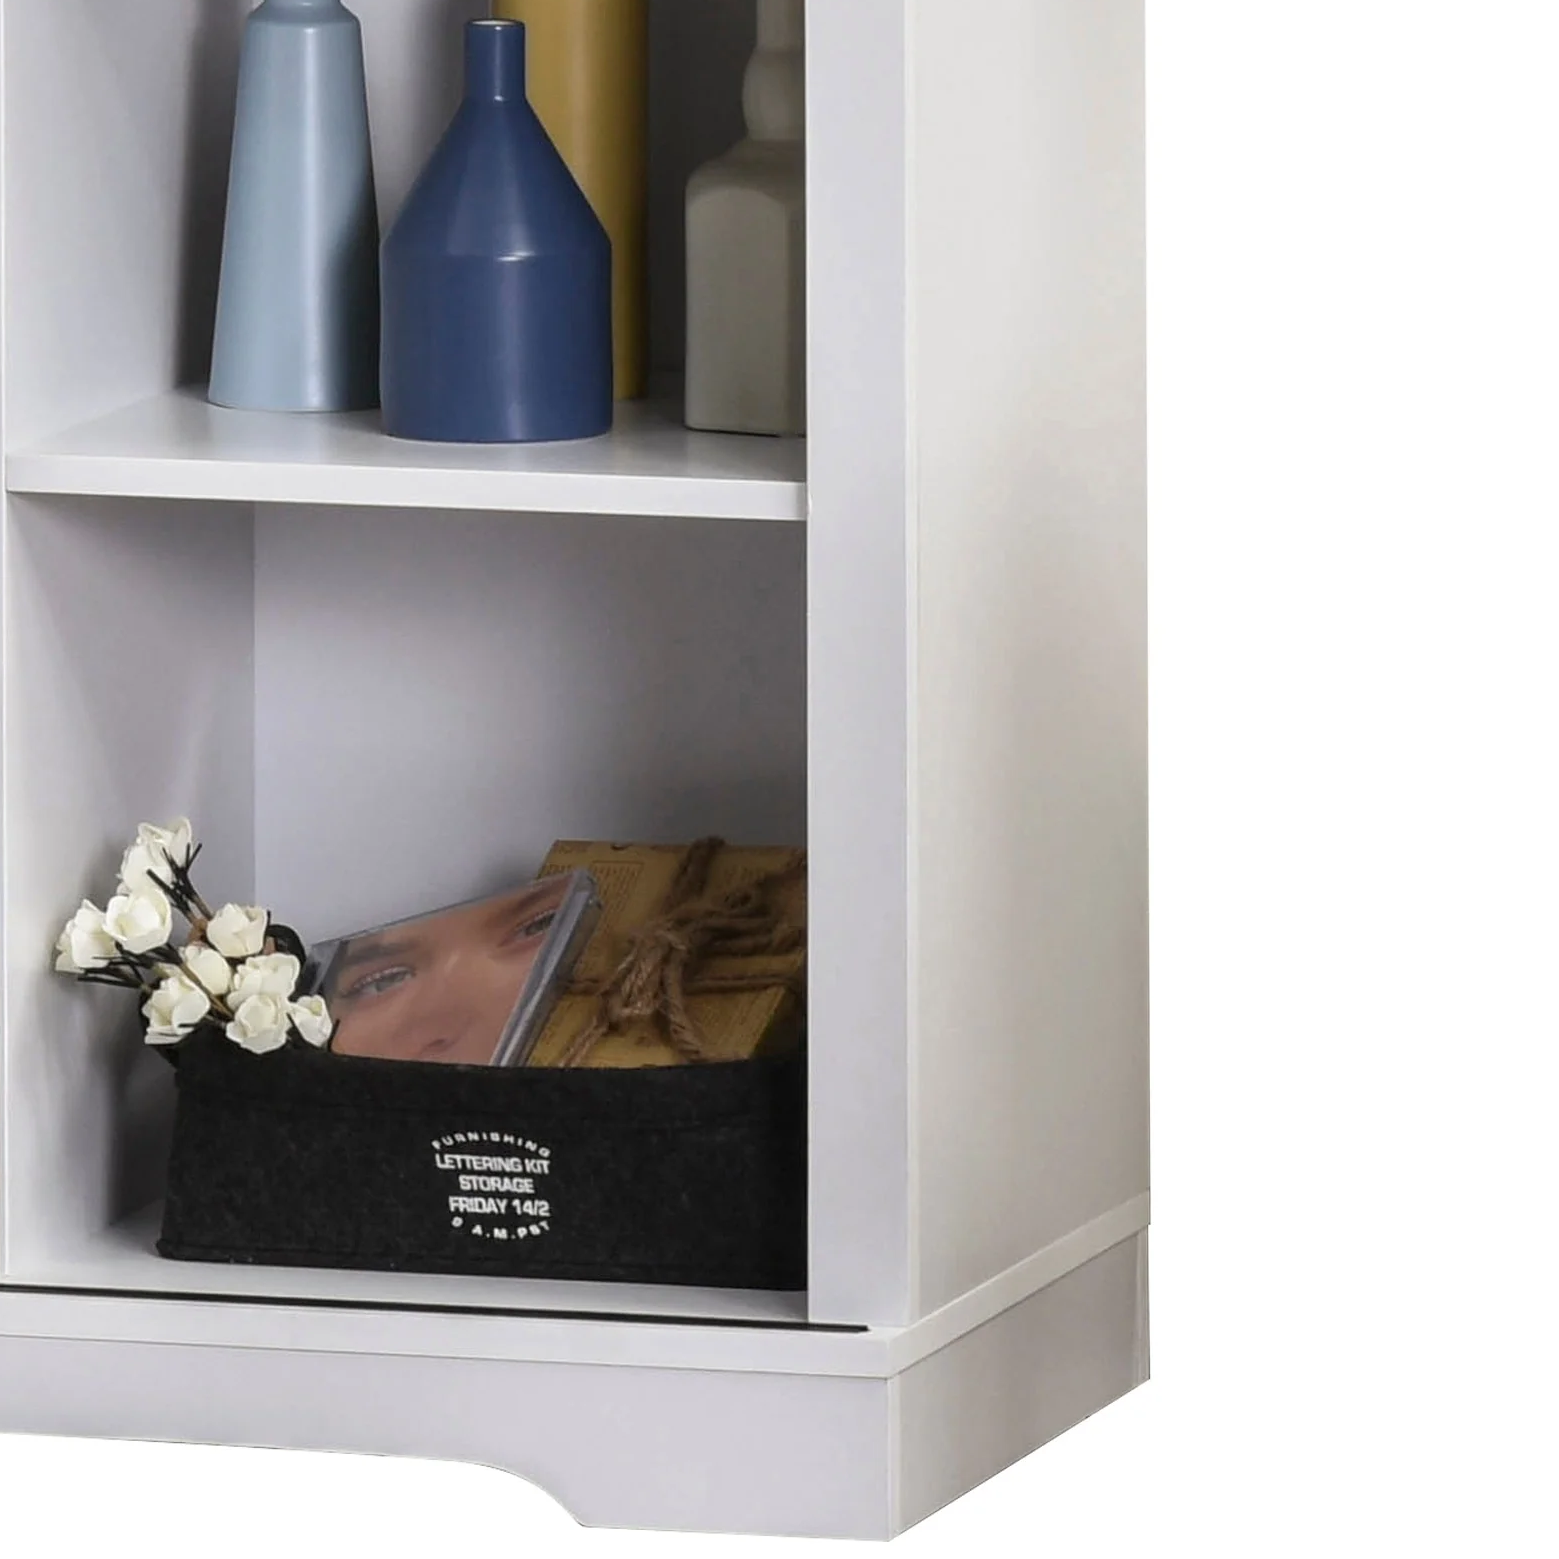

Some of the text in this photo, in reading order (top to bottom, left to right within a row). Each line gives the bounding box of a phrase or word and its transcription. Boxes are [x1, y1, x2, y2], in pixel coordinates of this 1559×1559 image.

[430, 1131, 551, 1159] FURNISHING
[435, 1152, 550, 1174] LETTERING KIT
[458, 1174, 535, 1194] STORAGE
[448, 1195, 551, 1218] FRIDAY 14/2
